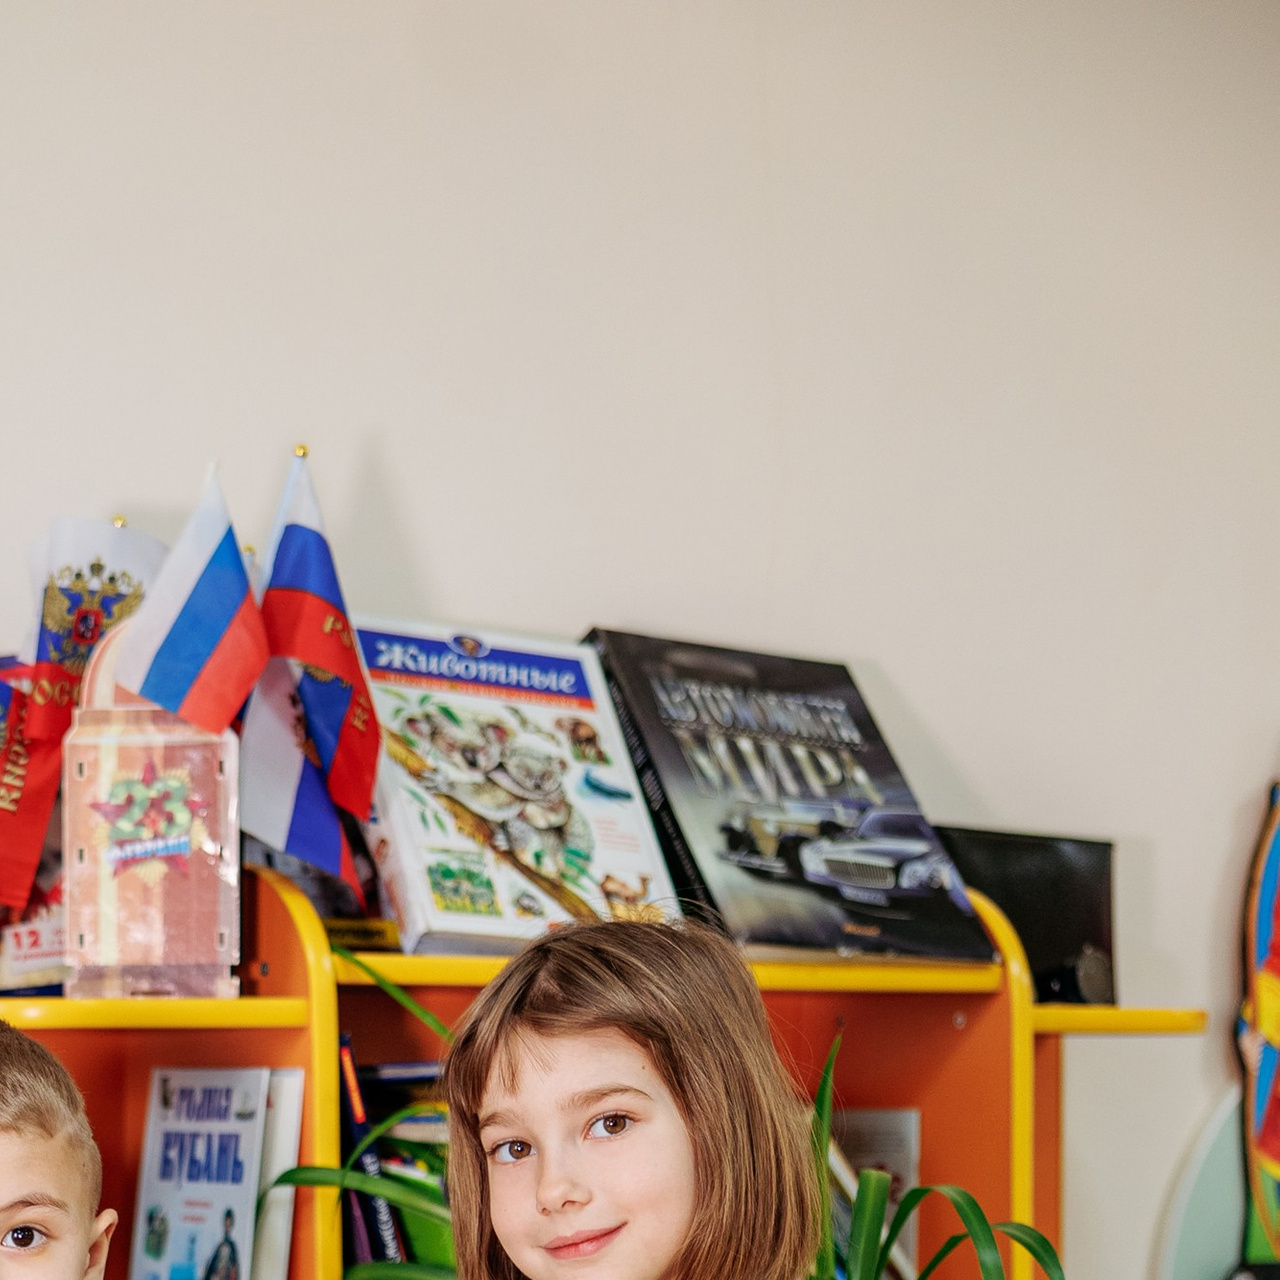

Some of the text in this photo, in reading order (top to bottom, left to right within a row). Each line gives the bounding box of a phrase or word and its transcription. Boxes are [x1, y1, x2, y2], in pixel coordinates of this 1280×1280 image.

[376, 640, 577, 694] Животные
[108, 779, 192, 841] 23
[160, 1131, 244, 1188] КУБАНЬ
